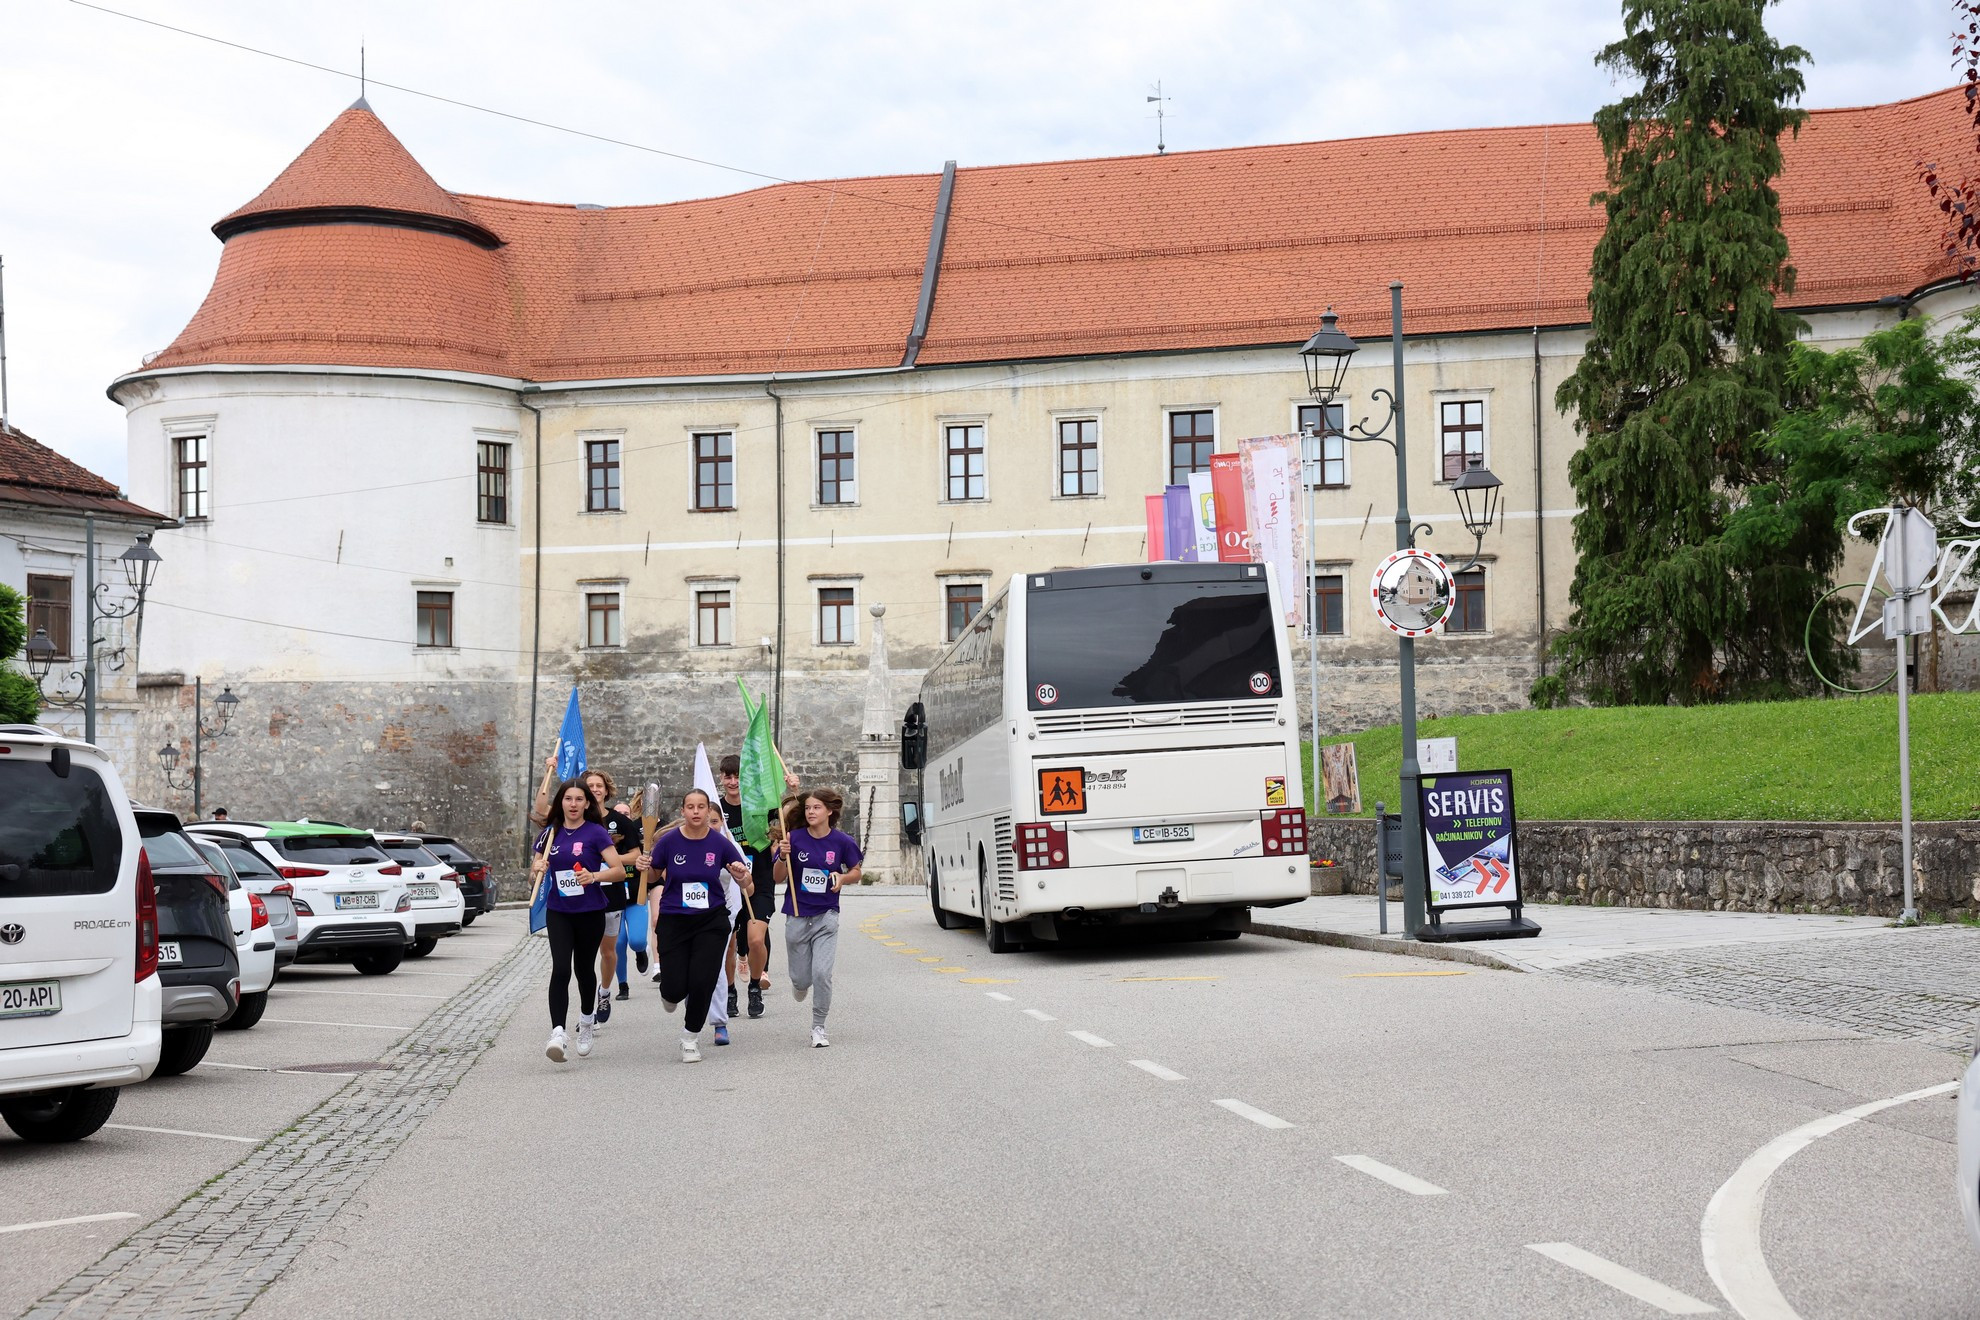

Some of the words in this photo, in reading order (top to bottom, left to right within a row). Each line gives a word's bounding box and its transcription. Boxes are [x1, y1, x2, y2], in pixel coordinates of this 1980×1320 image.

[1251, 676, 1268, 688] 100
[1039, 687, 1054, 699] 80
[1470, 778, 1503, 786] KOPRIVA
[1427, 788, 1504, 818] SERVIS
[1465, 817, 1502, 828] TELEFONOV
[1143, 828, 1155, 839] CE
[1161, 826, 1190, 838] IB-525
[1435, 830, 1483, 842] RAČUNALNIKOV
[804, 875, 826, 885] 9059
[417, 887, 437, 896] 28-FHS
[685, 890, 706, 901] 9064
[1440, 892, 1451, 900] 041
[1451, 891, 1463, 900] 339
[1463, 890, 1474, 899] 227
[342, 896, 350, 905] MB
[356, 895, 376, 905] 87-CHB
[74, 920, 116, 930] PROACE
[3, 986, 53, 1009] 20-API
